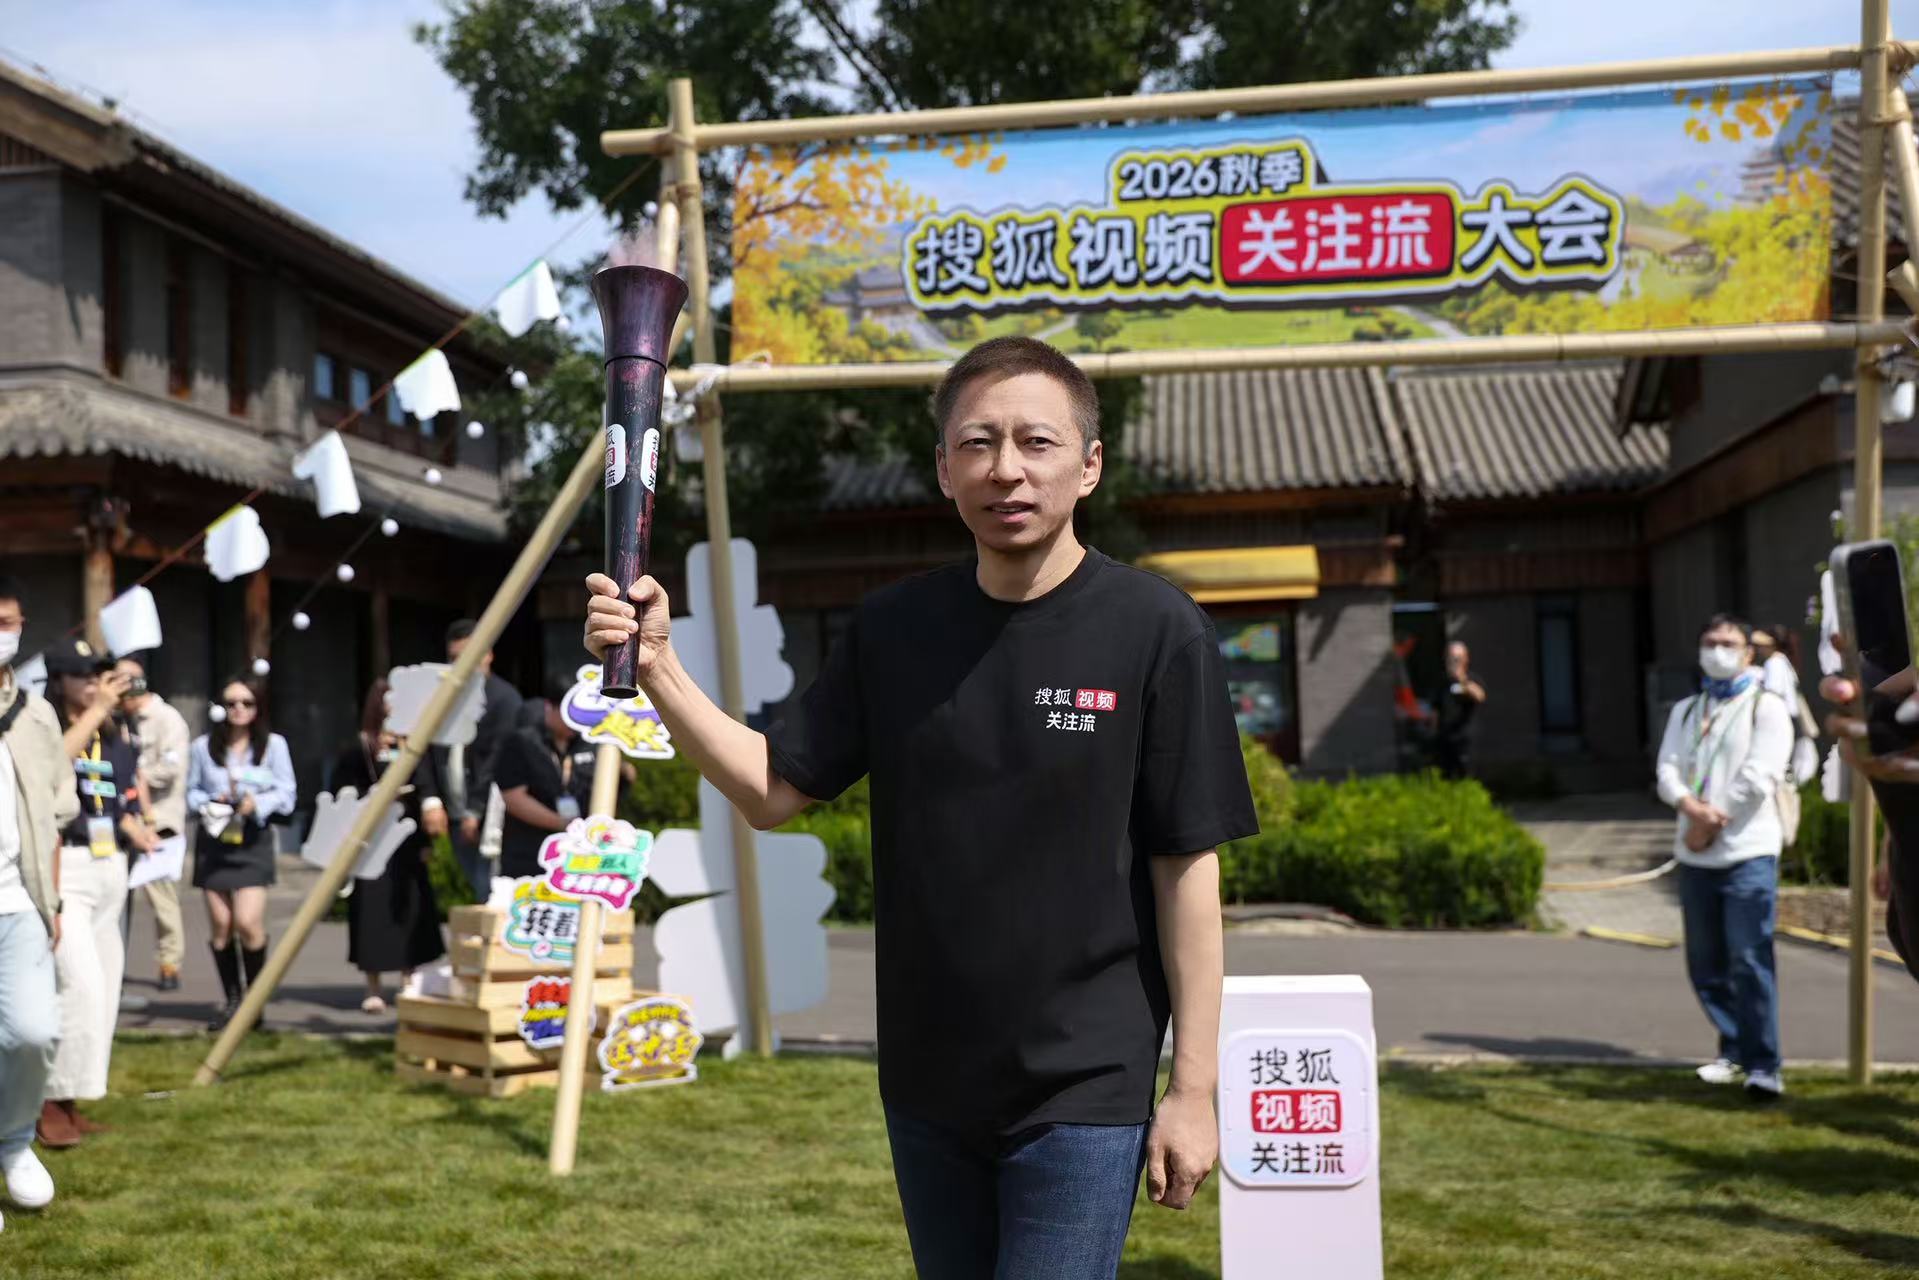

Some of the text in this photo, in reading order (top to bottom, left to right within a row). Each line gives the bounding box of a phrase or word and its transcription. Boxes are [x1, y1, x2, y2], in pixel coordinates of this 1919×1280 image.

[1119, 150, 1302, 199] 2026秋季
[915, 190, 1609, 292] 搜狐视频关注流大会
[1034, 687, 1114, 709] 搜狐视频
[1046, 711, 1096, 732] 关注流
[1250, 1048, 1340, 1085] 搜狐
[1255, 1092, 1338, 1131] 视频
[1251, 1142, 1344, 1174] 关注流
